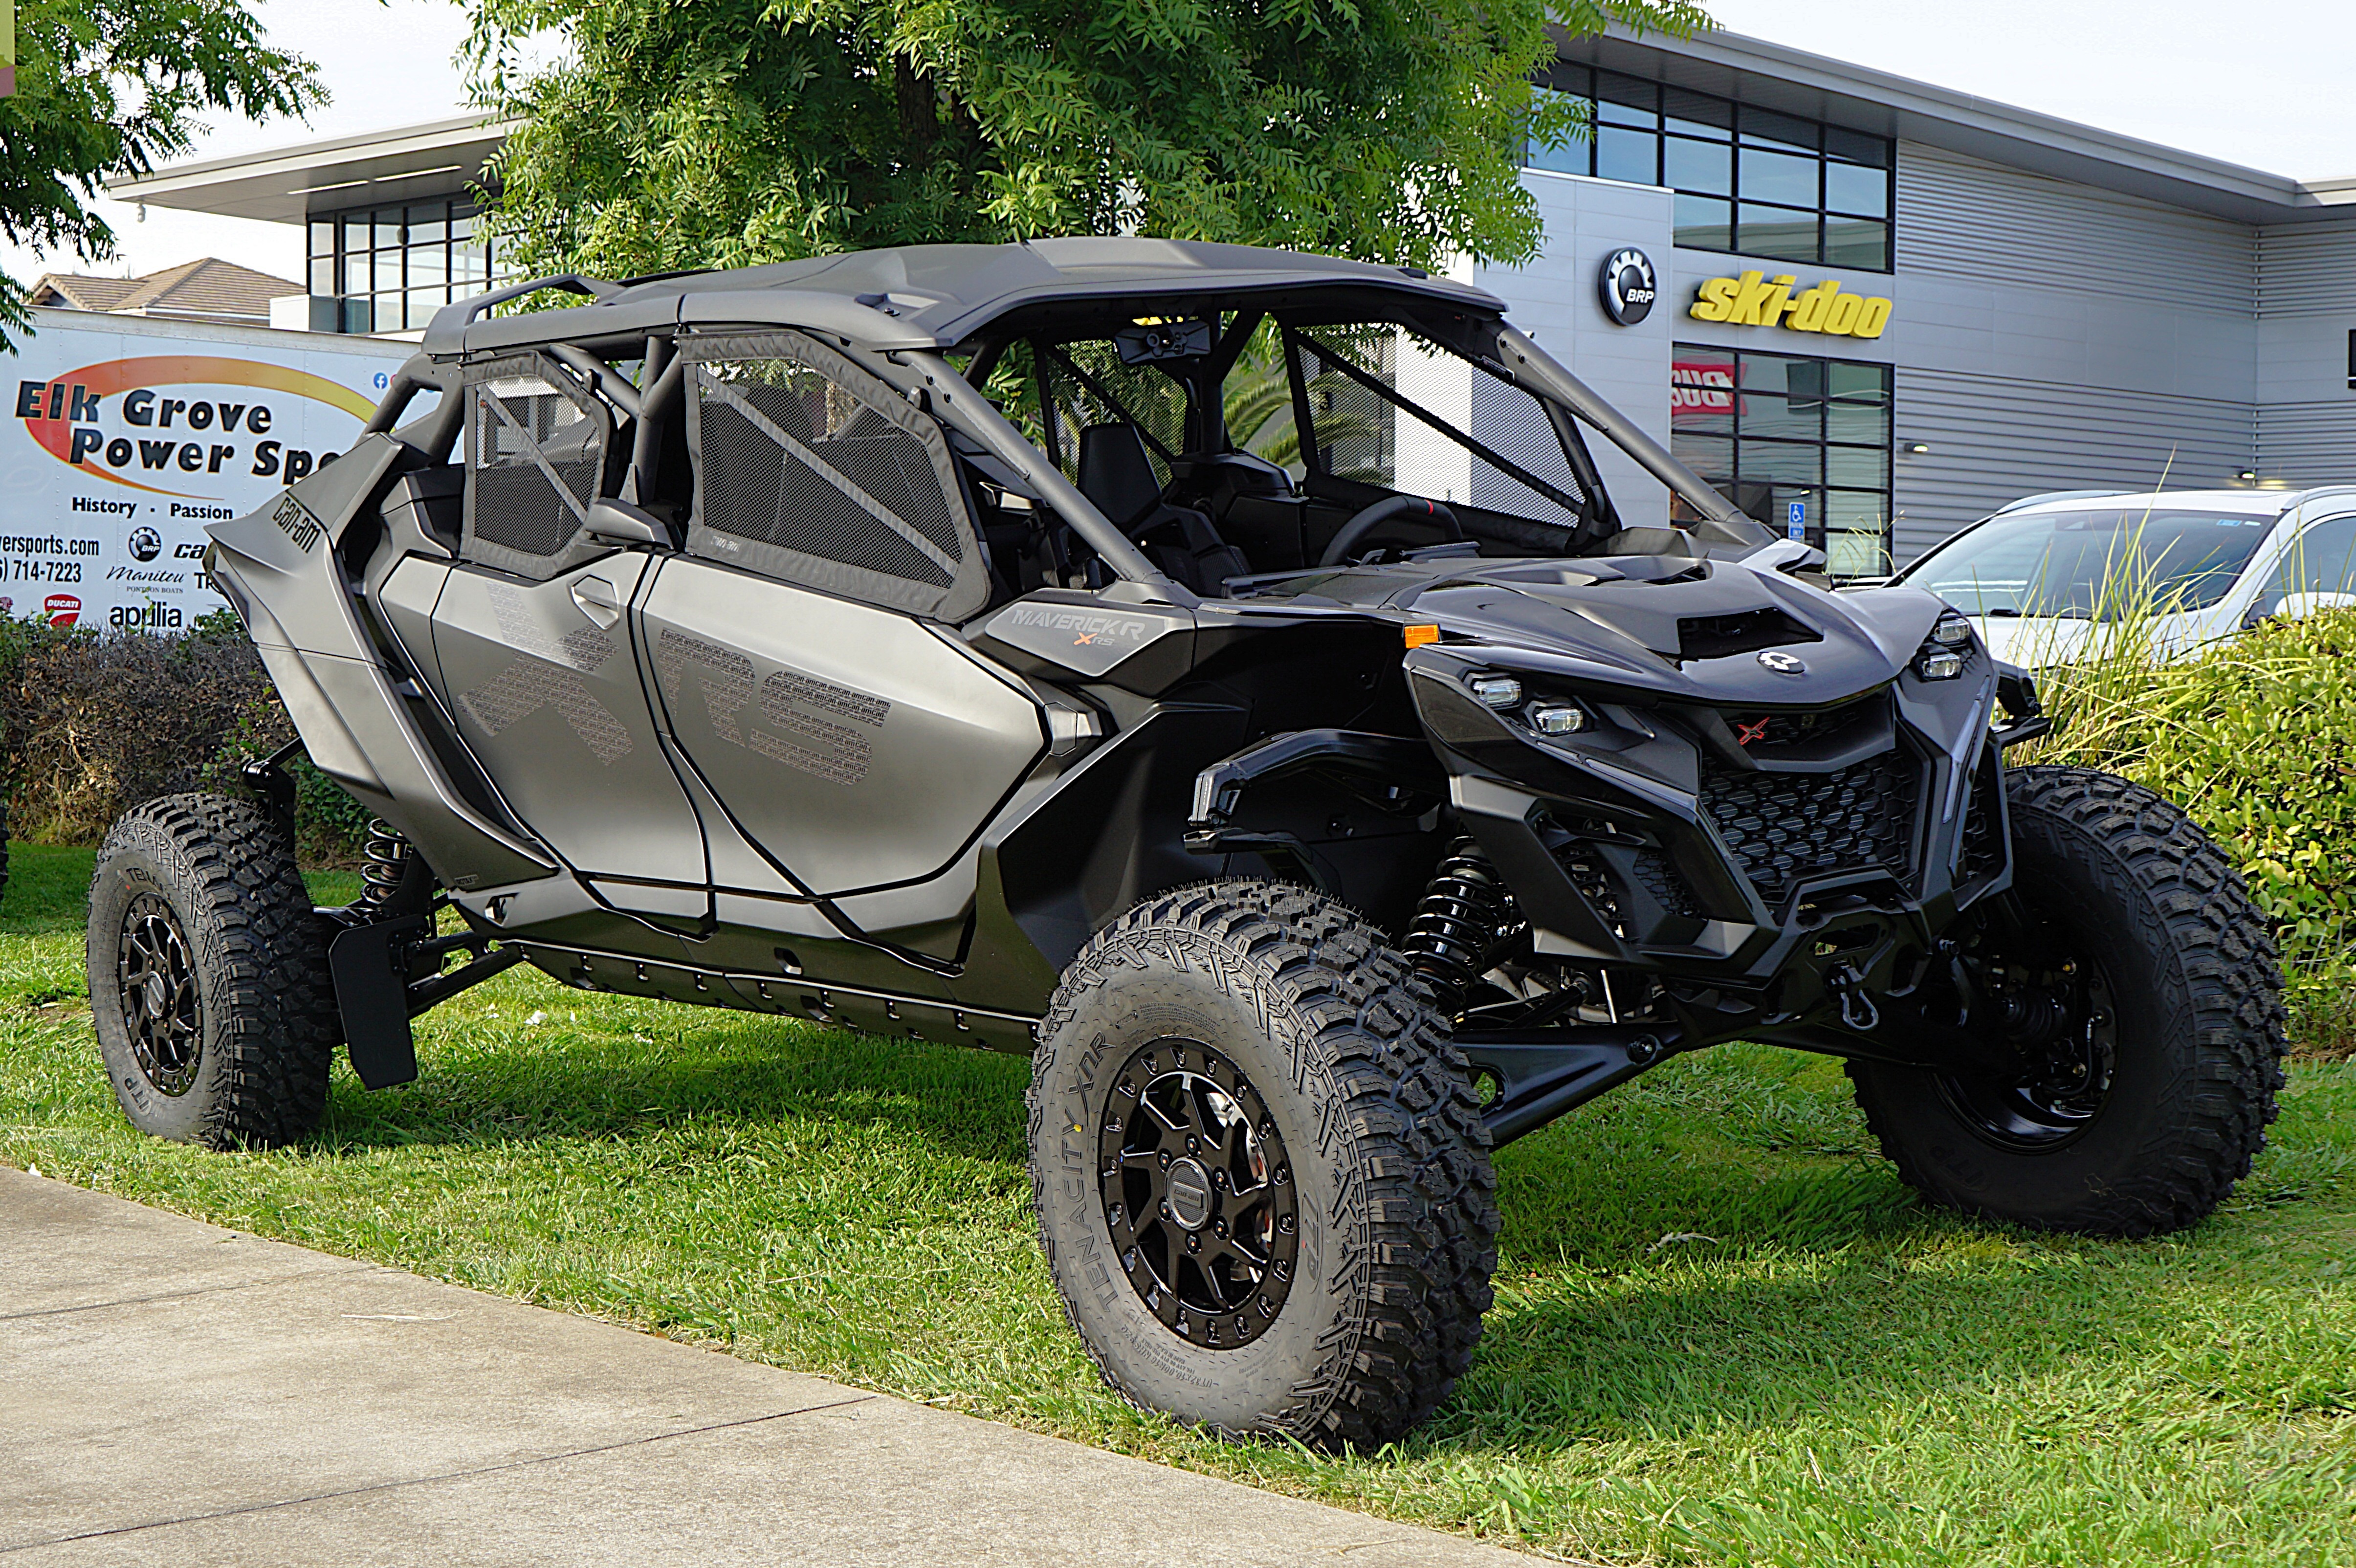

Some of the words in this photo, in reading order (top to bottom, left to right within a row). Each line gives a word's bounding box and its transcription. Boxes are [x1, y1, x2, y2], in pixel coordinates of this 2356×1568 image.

[1626, 288, 1654, 304] BRP
[1689, 269, 1893, 338] ski-doo
[15, 380, 102, 423] Elk
[123, 389, 272, 434] Grove
[68, 427, 234, 473] Power
[72, 497, 137, 518] History
[170, 503, 233, 519] Passion
[272, 496, 321, 554] can-am
[14, 559, 81, 583] 714-7223
[106, 566, 185, 583] Manitou
[47, 599, 79, 608] DUCATI
[1012, 609, 1121, 635] MAVERICK
[1120, 621, 1145, 640] R
